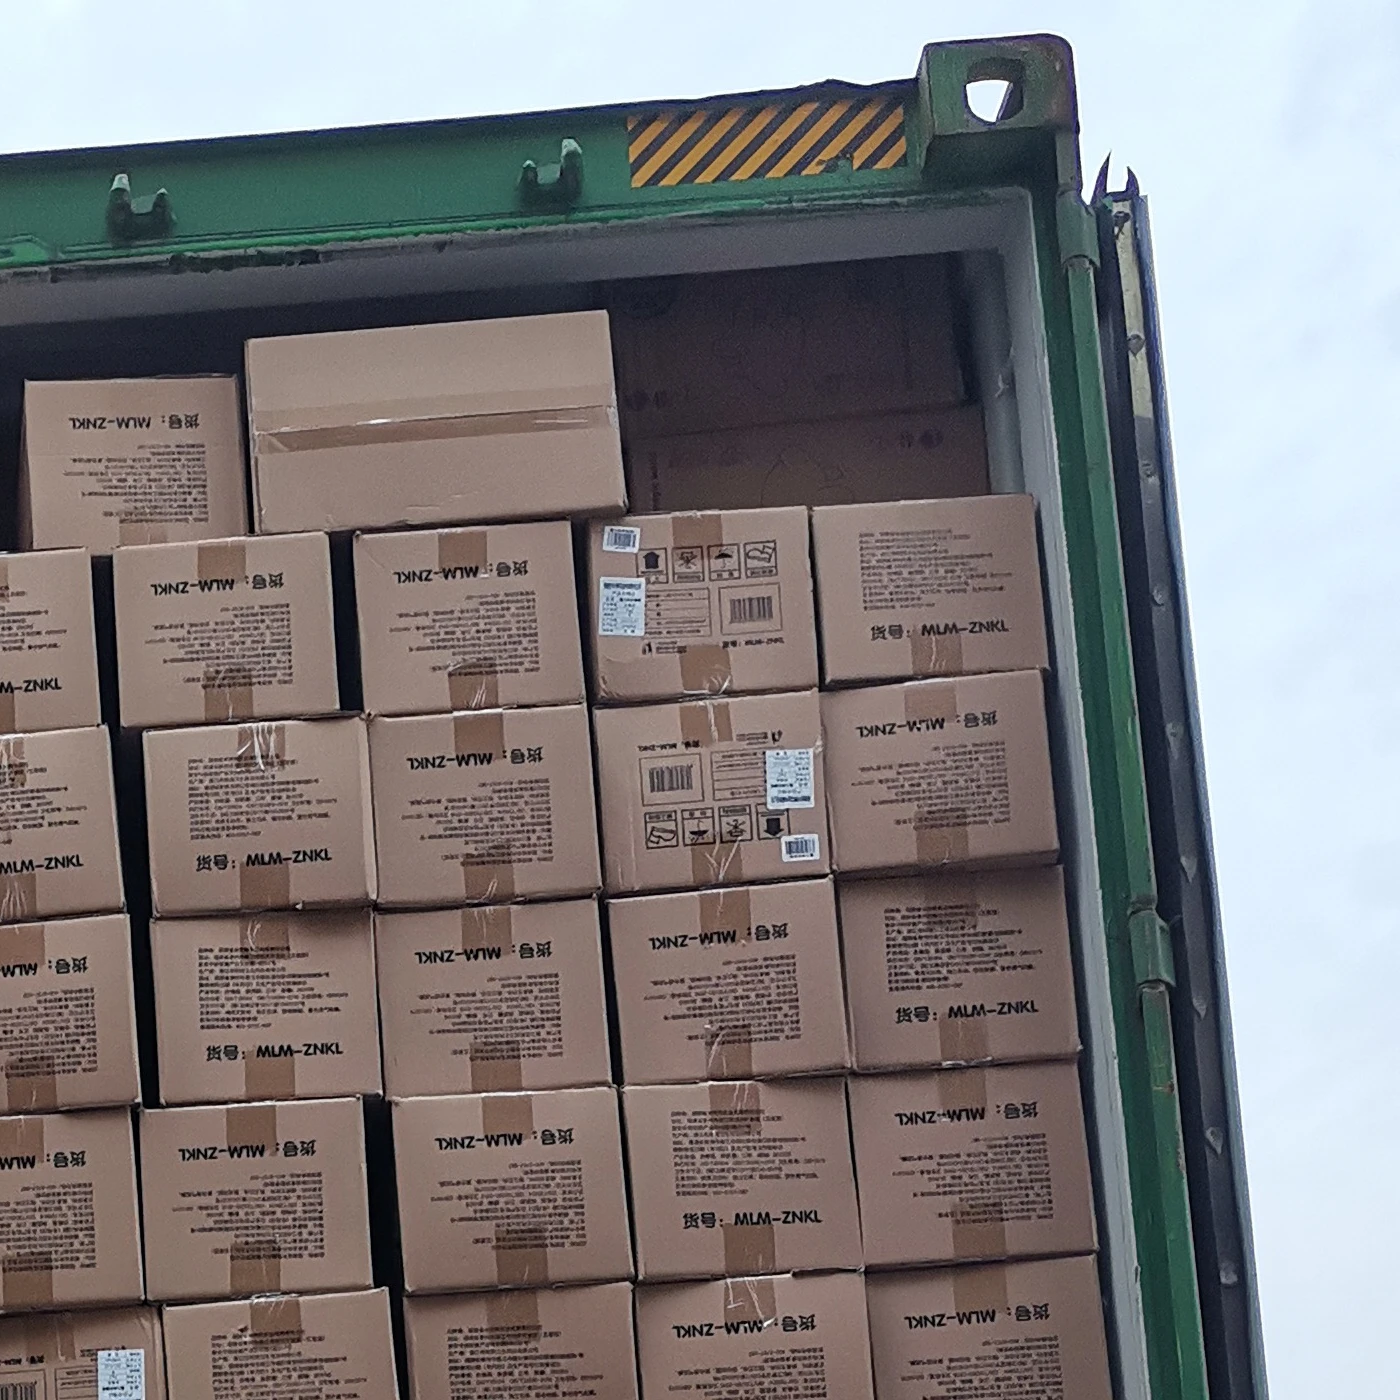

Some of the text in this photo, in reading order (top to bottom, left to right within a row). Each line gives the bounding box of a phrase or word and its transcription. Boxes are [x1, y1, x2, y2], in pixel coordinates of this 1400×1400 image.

[68, 416, 152, 430] MLM-ZNKL
[392, 564, 480, 585] MLM-ZNKL
[149, 577, 235, 597] MLM-ZNKL
[920, 618, 1010, 638] MLM-ZNKL
[405, 752, 494, 771] MLM-ZNKL
[245, 847, 333, 868] MLM-ZNKL
[647, 928, 737, 951] MLM-ZNKL
[413, 946, 502, 965] MLM-ZNKL
[947, 999, 1040, 1020] MLM-ZNKL
[255, 1041, 344, 1059] MLM-ZNKL
[433, 1132, 524, 1151] MLM-ZNKL
[177, 1143, 266, 1162] MLM-ZNKL
[733, 1209, 824, 1227] MLM-ZNKL
[903, 1308, 997, 1330] MLM-ZNKL
